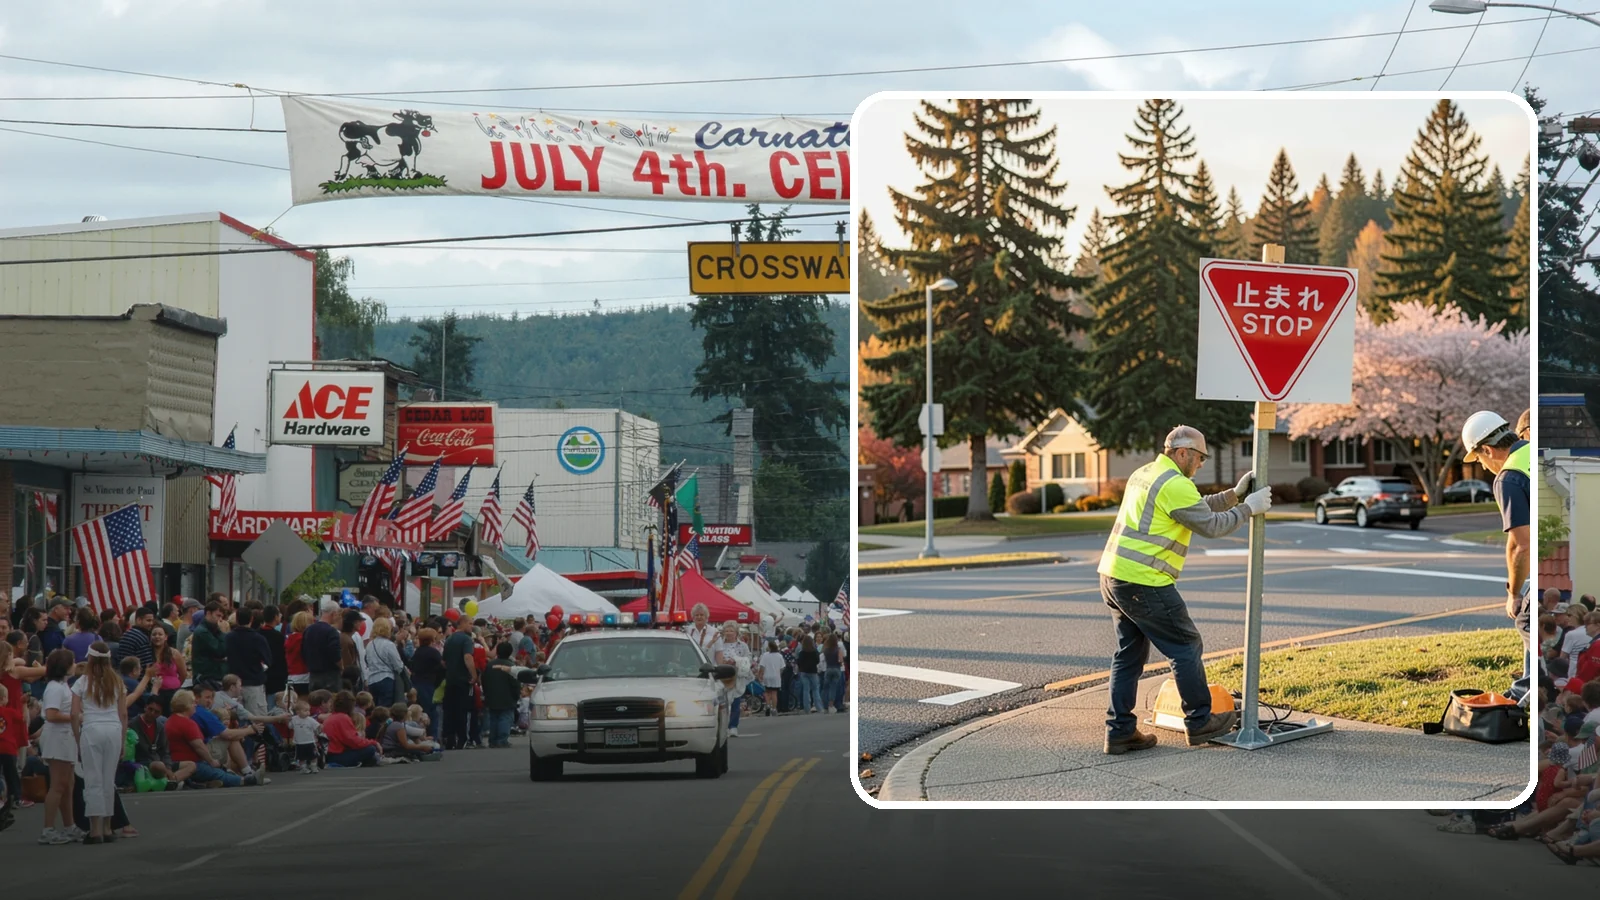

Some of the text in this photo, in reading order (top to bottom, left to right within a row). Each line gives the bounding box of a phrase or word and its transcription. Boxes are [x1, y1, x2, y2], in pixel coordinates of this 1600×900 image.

[481, 141, 605, 192] JULY
[632, 150, 746, 198] 4th.
[697, 254, 850, 280] CROSSWA
[1233, 281, 1324, 312] 止まれ
[1242, 312, 1313, 336] STOP
[283, 380, 373, 420] ACE
[406, 409, 485, 422] CEDAR LOG
[284, 421, 371, 436] Hardware
[416, 428, 477, 447] Coca-Cola
[353, 467, 385, 480] Simpl
[83, 486, 155, 495] St. Vincent de Paul
[213, 515, 330, 535] HARDARE
[688, 526, 741, 535] CRNATION
[699, 535, 730, 543] GLASS
